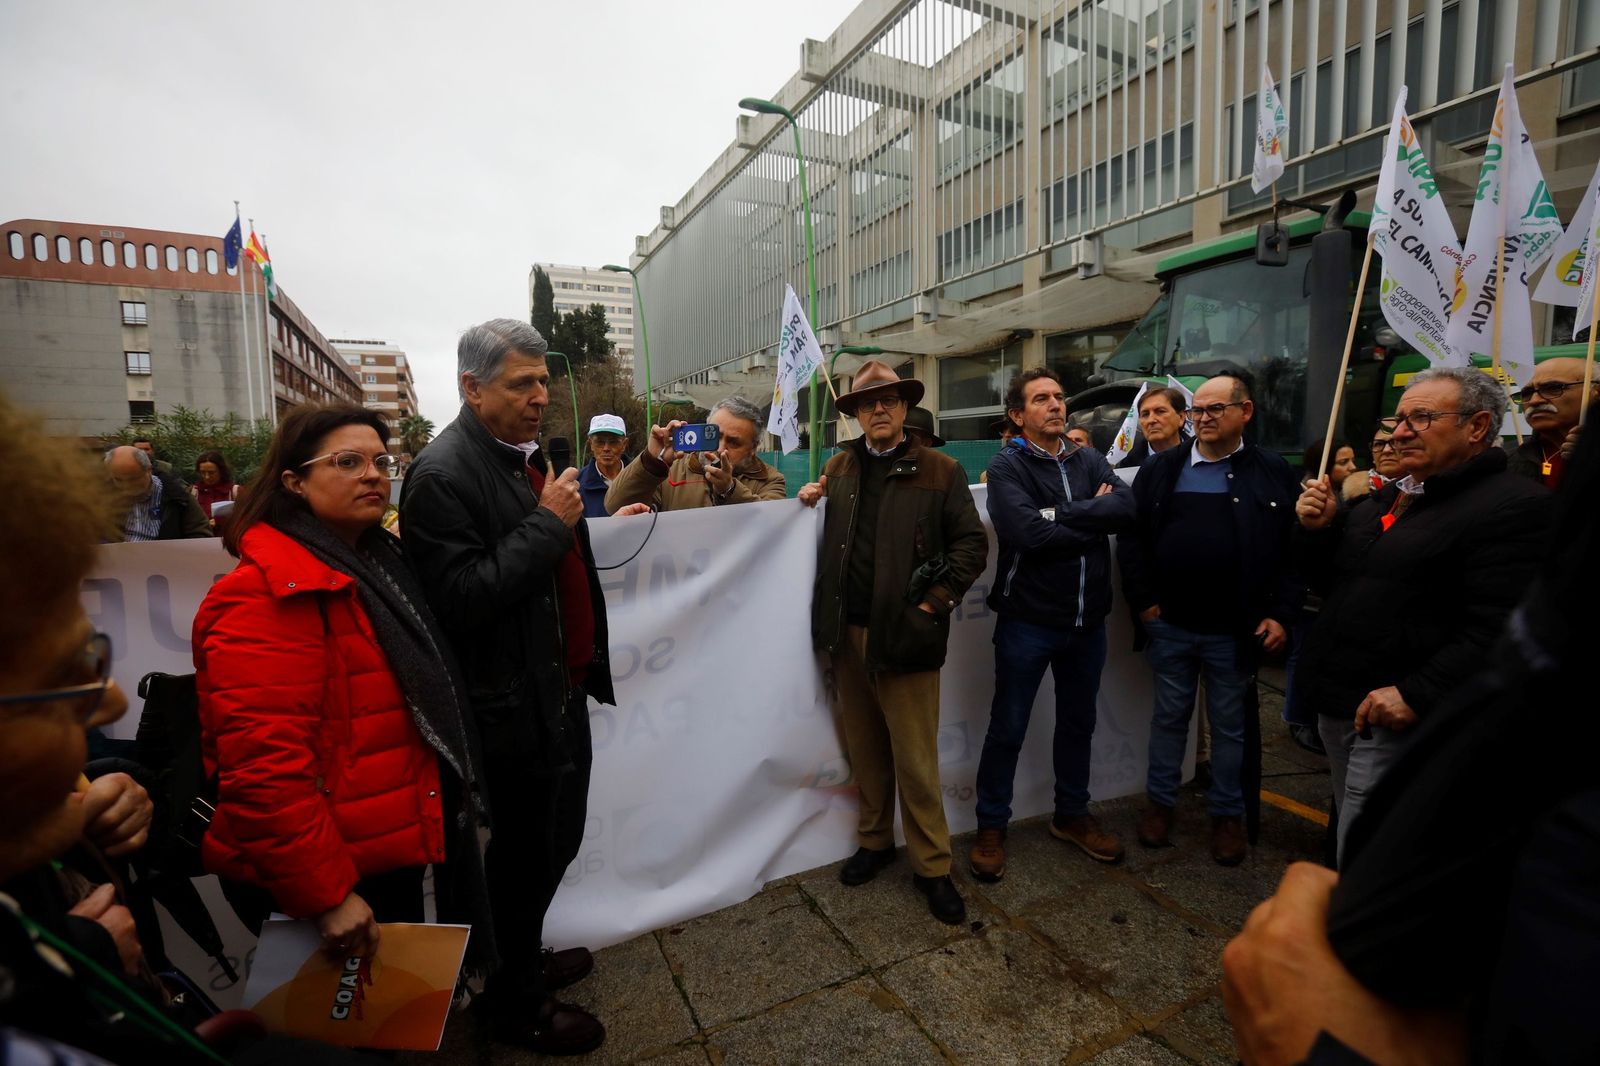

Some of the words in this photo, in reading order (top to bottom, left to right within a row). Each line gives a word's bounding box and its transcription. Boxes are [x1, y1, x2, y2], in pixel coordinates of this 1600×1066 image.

[1389, 293, 1453, 355] agro-alimentarias
[1395, 285, 1446, 333] cooperativas
[331, 957, 361, 1019] COAG
